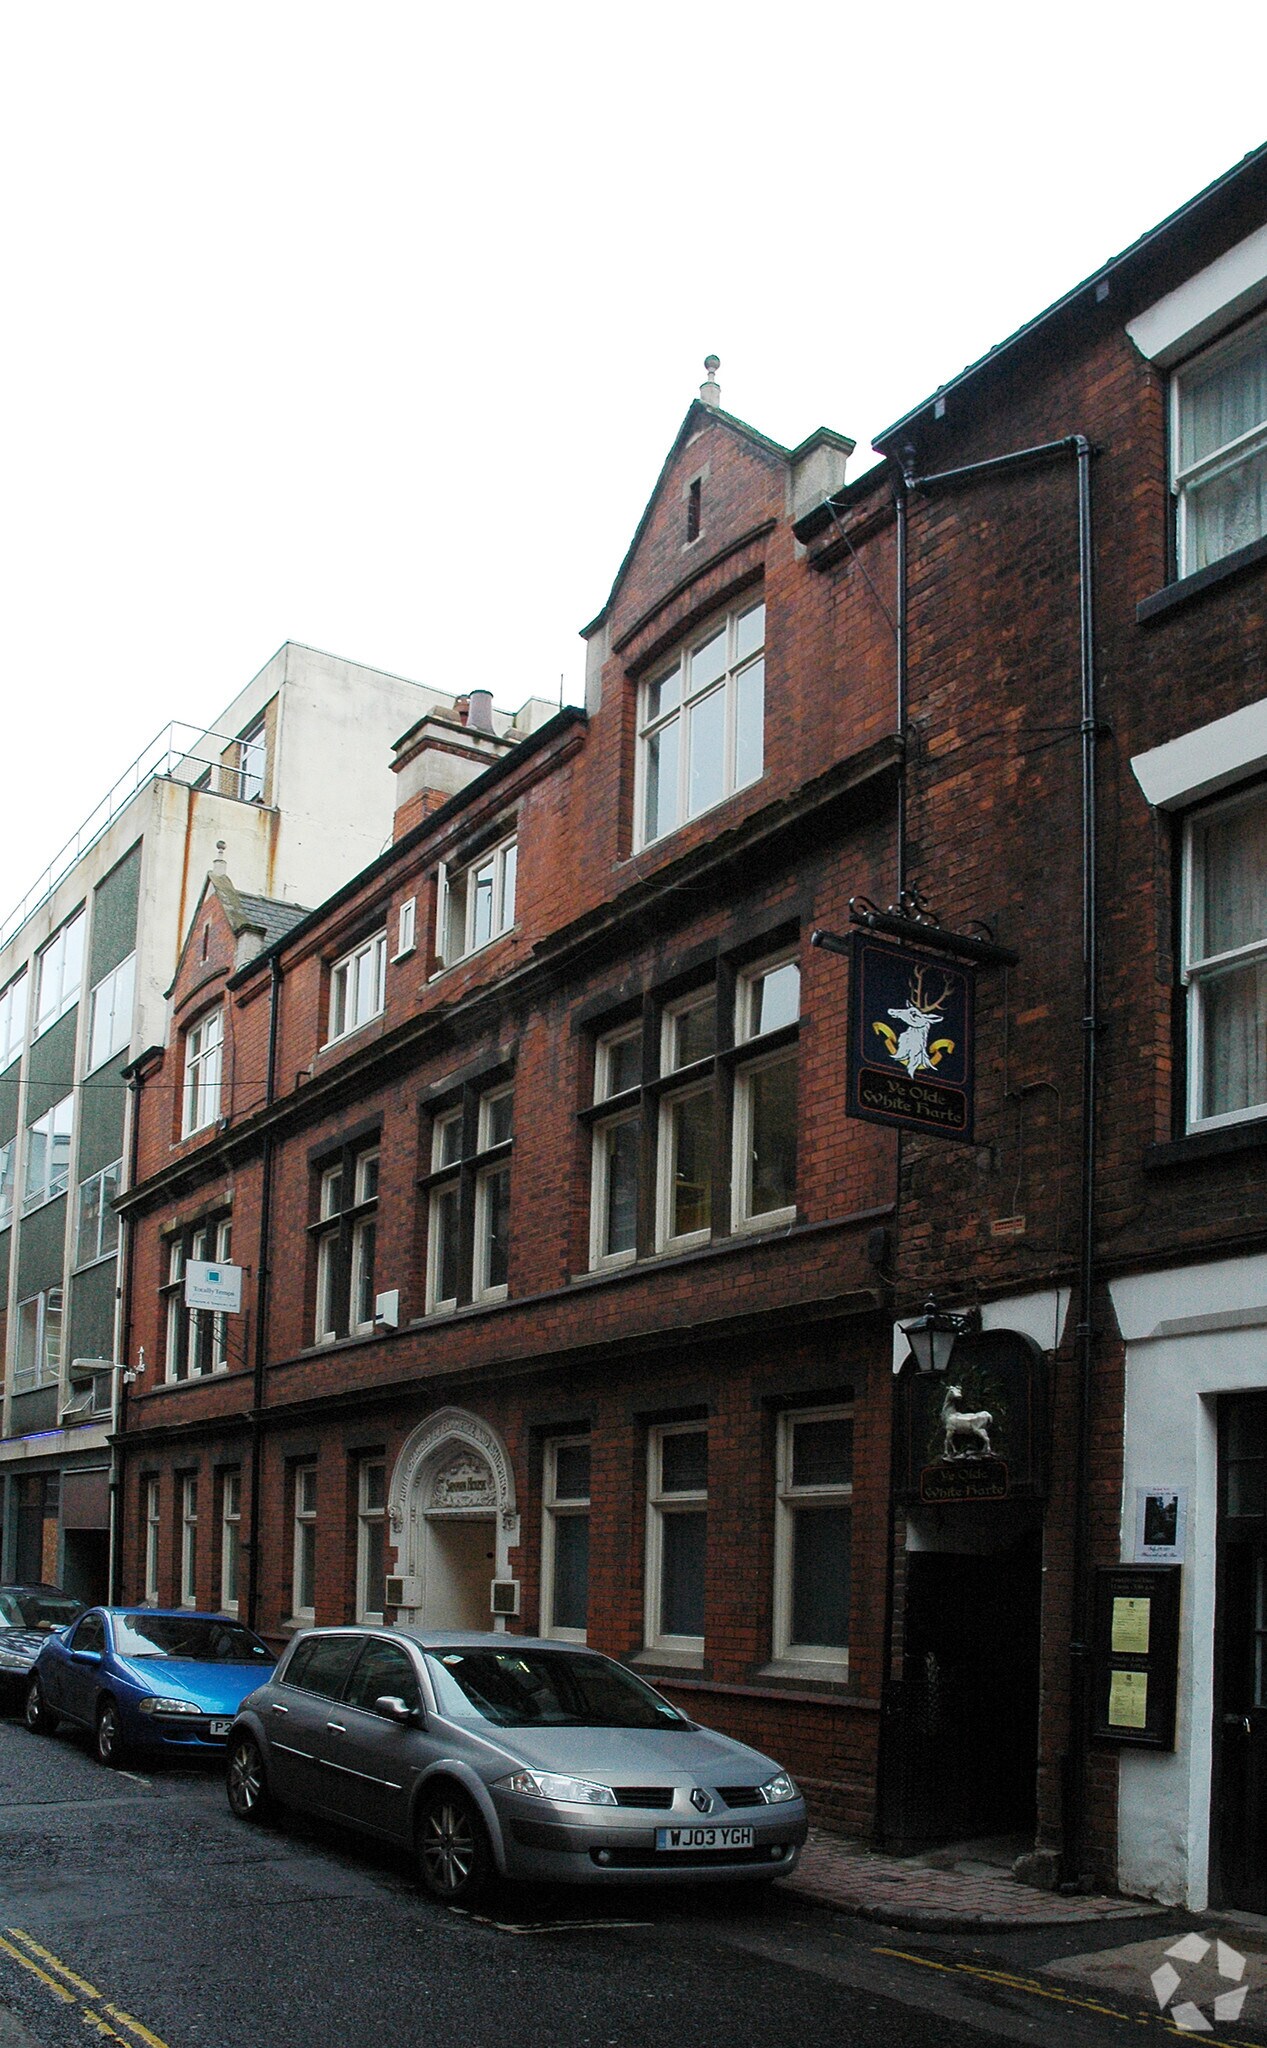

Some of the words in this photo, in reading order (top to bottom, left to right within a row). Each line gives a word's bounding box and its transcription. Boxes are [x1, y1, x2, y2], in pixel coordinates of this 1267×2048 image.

[887, 1080, 906, 1096] Ye
[909, 1086, 946, 1105] Olde
[863, 1090, 912, 1111] White
[916, 1101, 962, 1123] Harte
[924, 1486, 963, 1498] White
[966, 1483, 1004, 1496] Harte
[671, 1830, 716, 1846] WJ03
[721, 1829, 751, 1844] YGH
